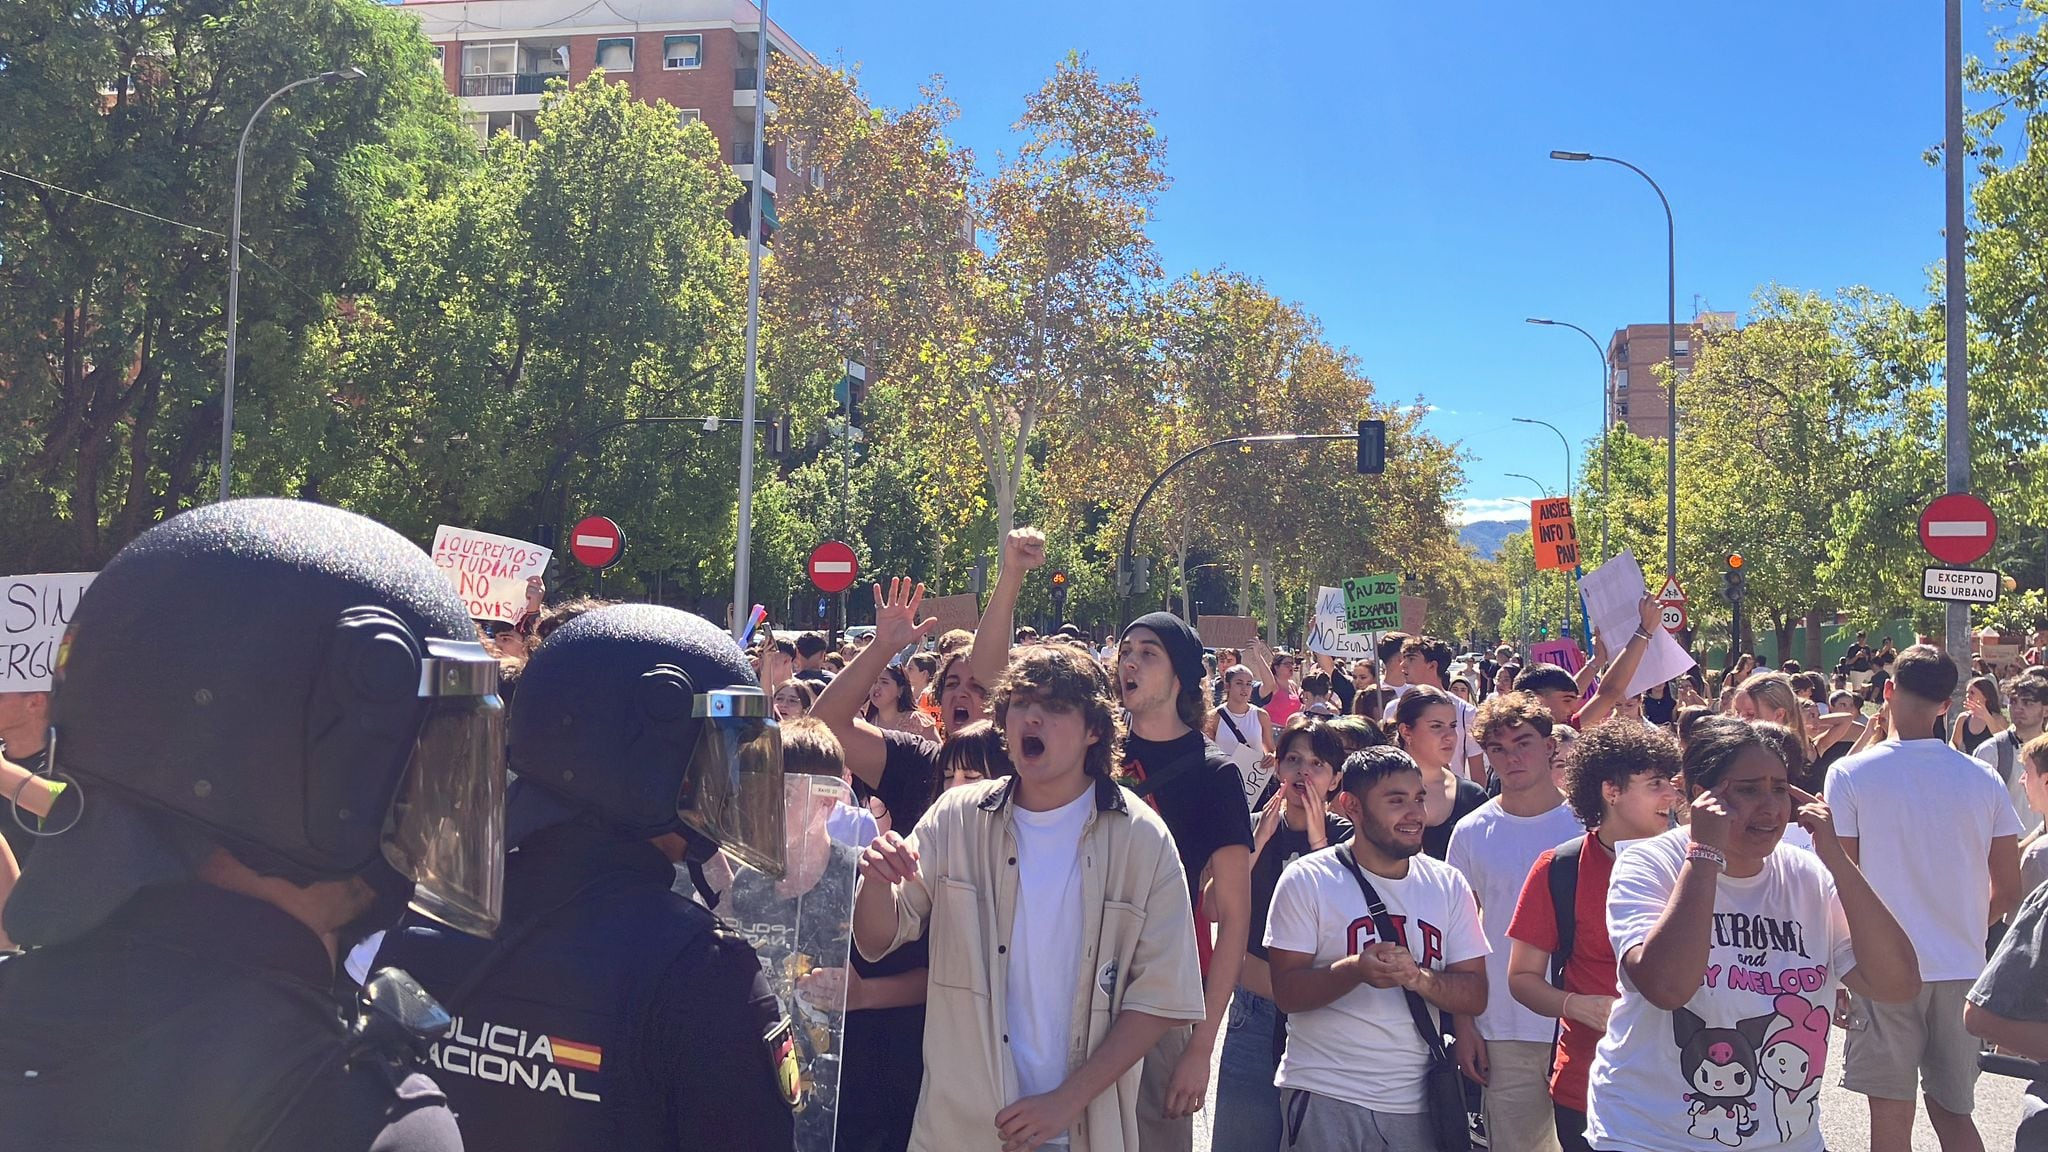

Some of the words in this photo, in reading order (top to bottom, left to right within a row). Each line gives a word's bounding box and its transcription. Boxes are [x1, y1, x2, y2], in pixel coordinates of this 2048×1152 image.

[1539, 522, 1563, 543] INFO
[435, 552, 521, 580] ESTUDIAR
[1938, 573, 1984, 584] EXCEPTO
[460, 571, 489, 599] NO
[1375, 581, 1396, 595] 2025
[1927, 585, 1947, 595] BUS
[1951, 587, 1994, 598] URBANO
[5, 583, 84, 634] SIN
[1663, 613, 1680, 623] 30
[1309, 622, 1335, 651] NO
[1711, 912, 1811, 959] UROMI
[1737, 951, 1768, 967] and
[1700, 963, 1722, 989] Y
[416, 1042, 601, 1102] ACIONAL
